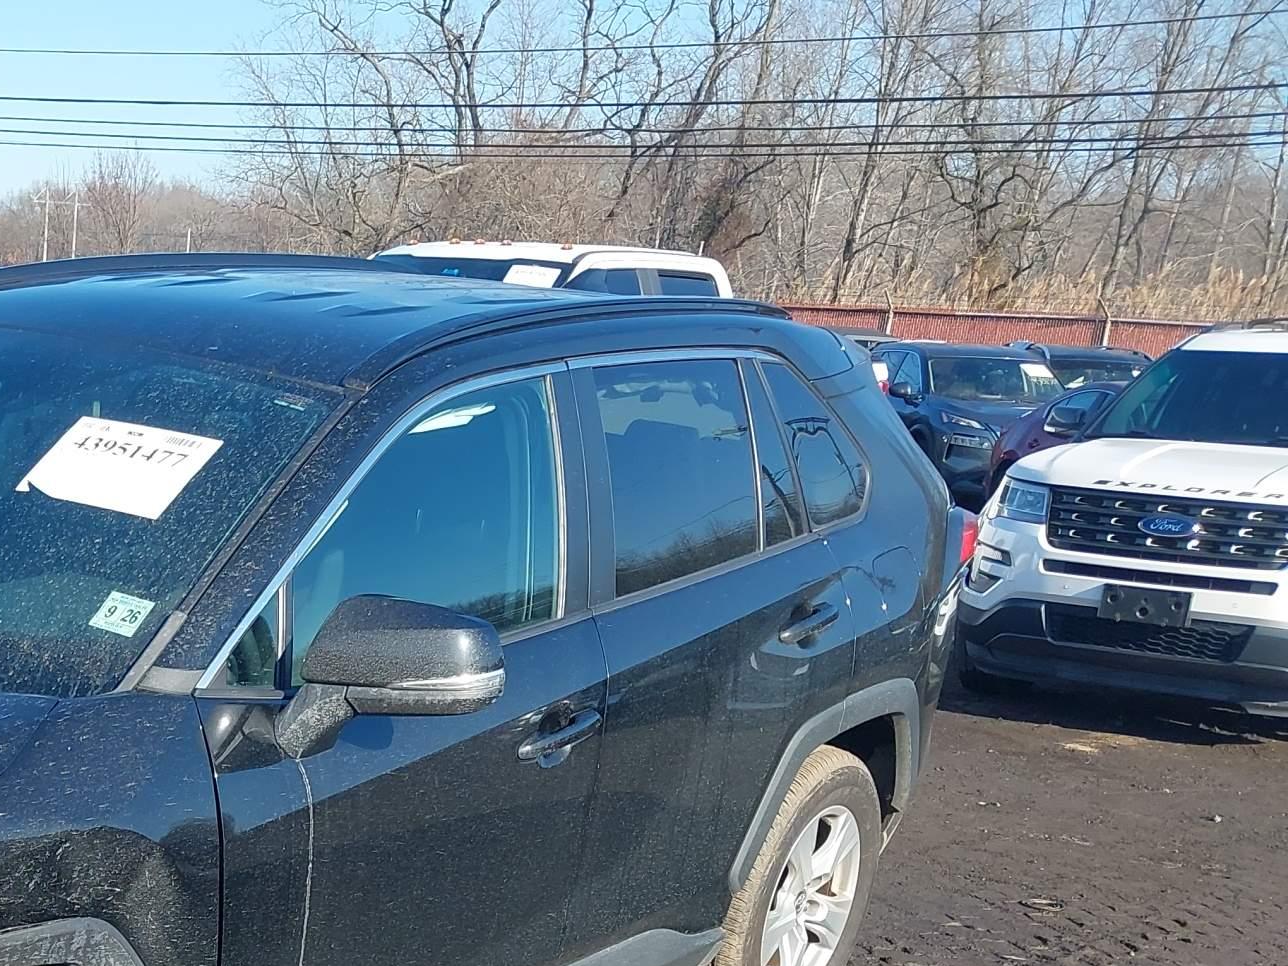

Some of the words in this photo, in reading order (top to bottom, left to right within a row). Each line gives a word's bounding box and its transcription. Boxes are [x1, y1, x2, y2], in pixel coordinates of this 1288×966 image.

[74, 436, 189, 467] 43951477
[1092, 479, 1285, 499] EXPLORER
[1149, 517, 1186, 533] Ford
[104, 605, 118, 618] 9
[119, 608, 142, 625] 26
